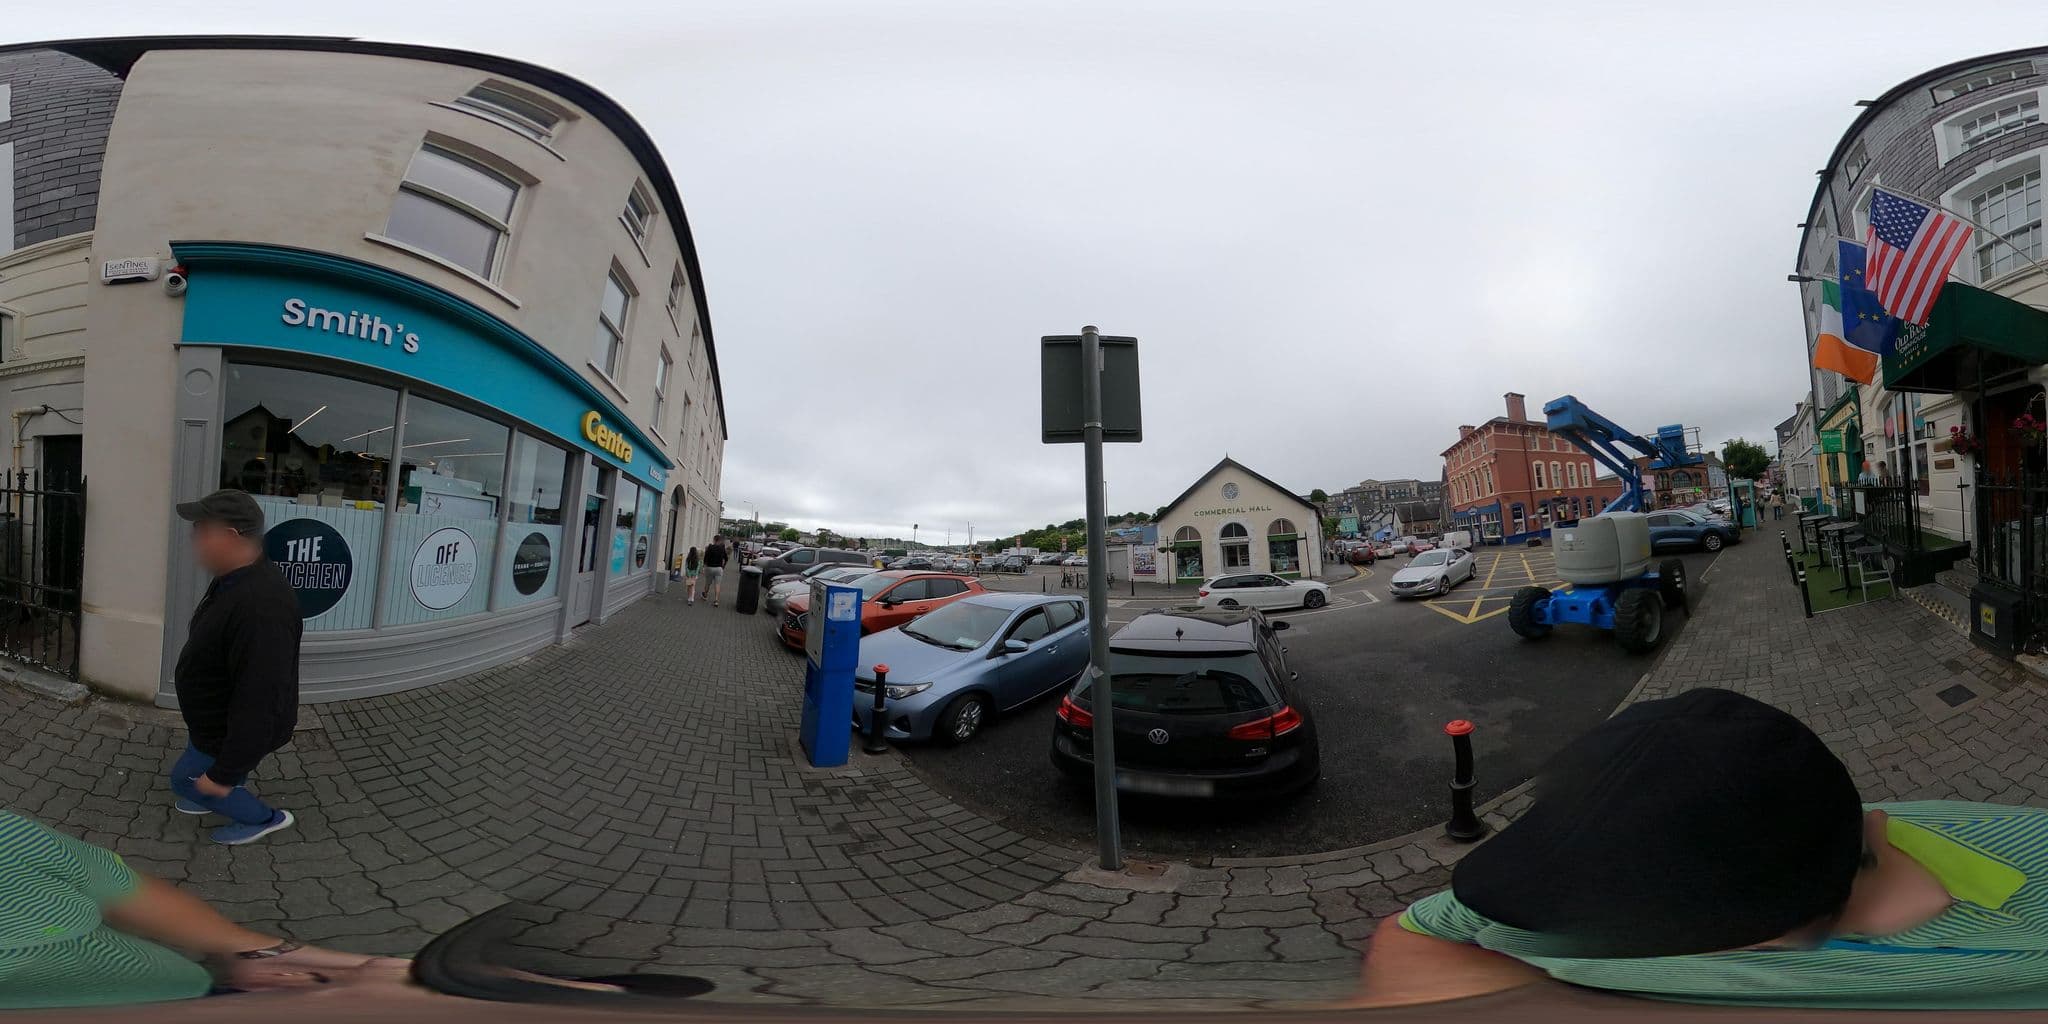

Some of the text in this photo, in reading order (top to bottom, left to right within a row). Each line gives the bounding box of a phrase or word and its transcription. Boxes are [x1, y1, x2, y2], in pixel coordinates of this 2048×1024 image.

[282, 298, 420, 353] Smith's
[582, 410, 633, 463] Centra
[1194, 507, 1247, 517] COMMERCIAL
[287, 535, 323, 563] THE
[436, 541, 460, 565] OFF
[273, 561, 346, 589] TCHEN
